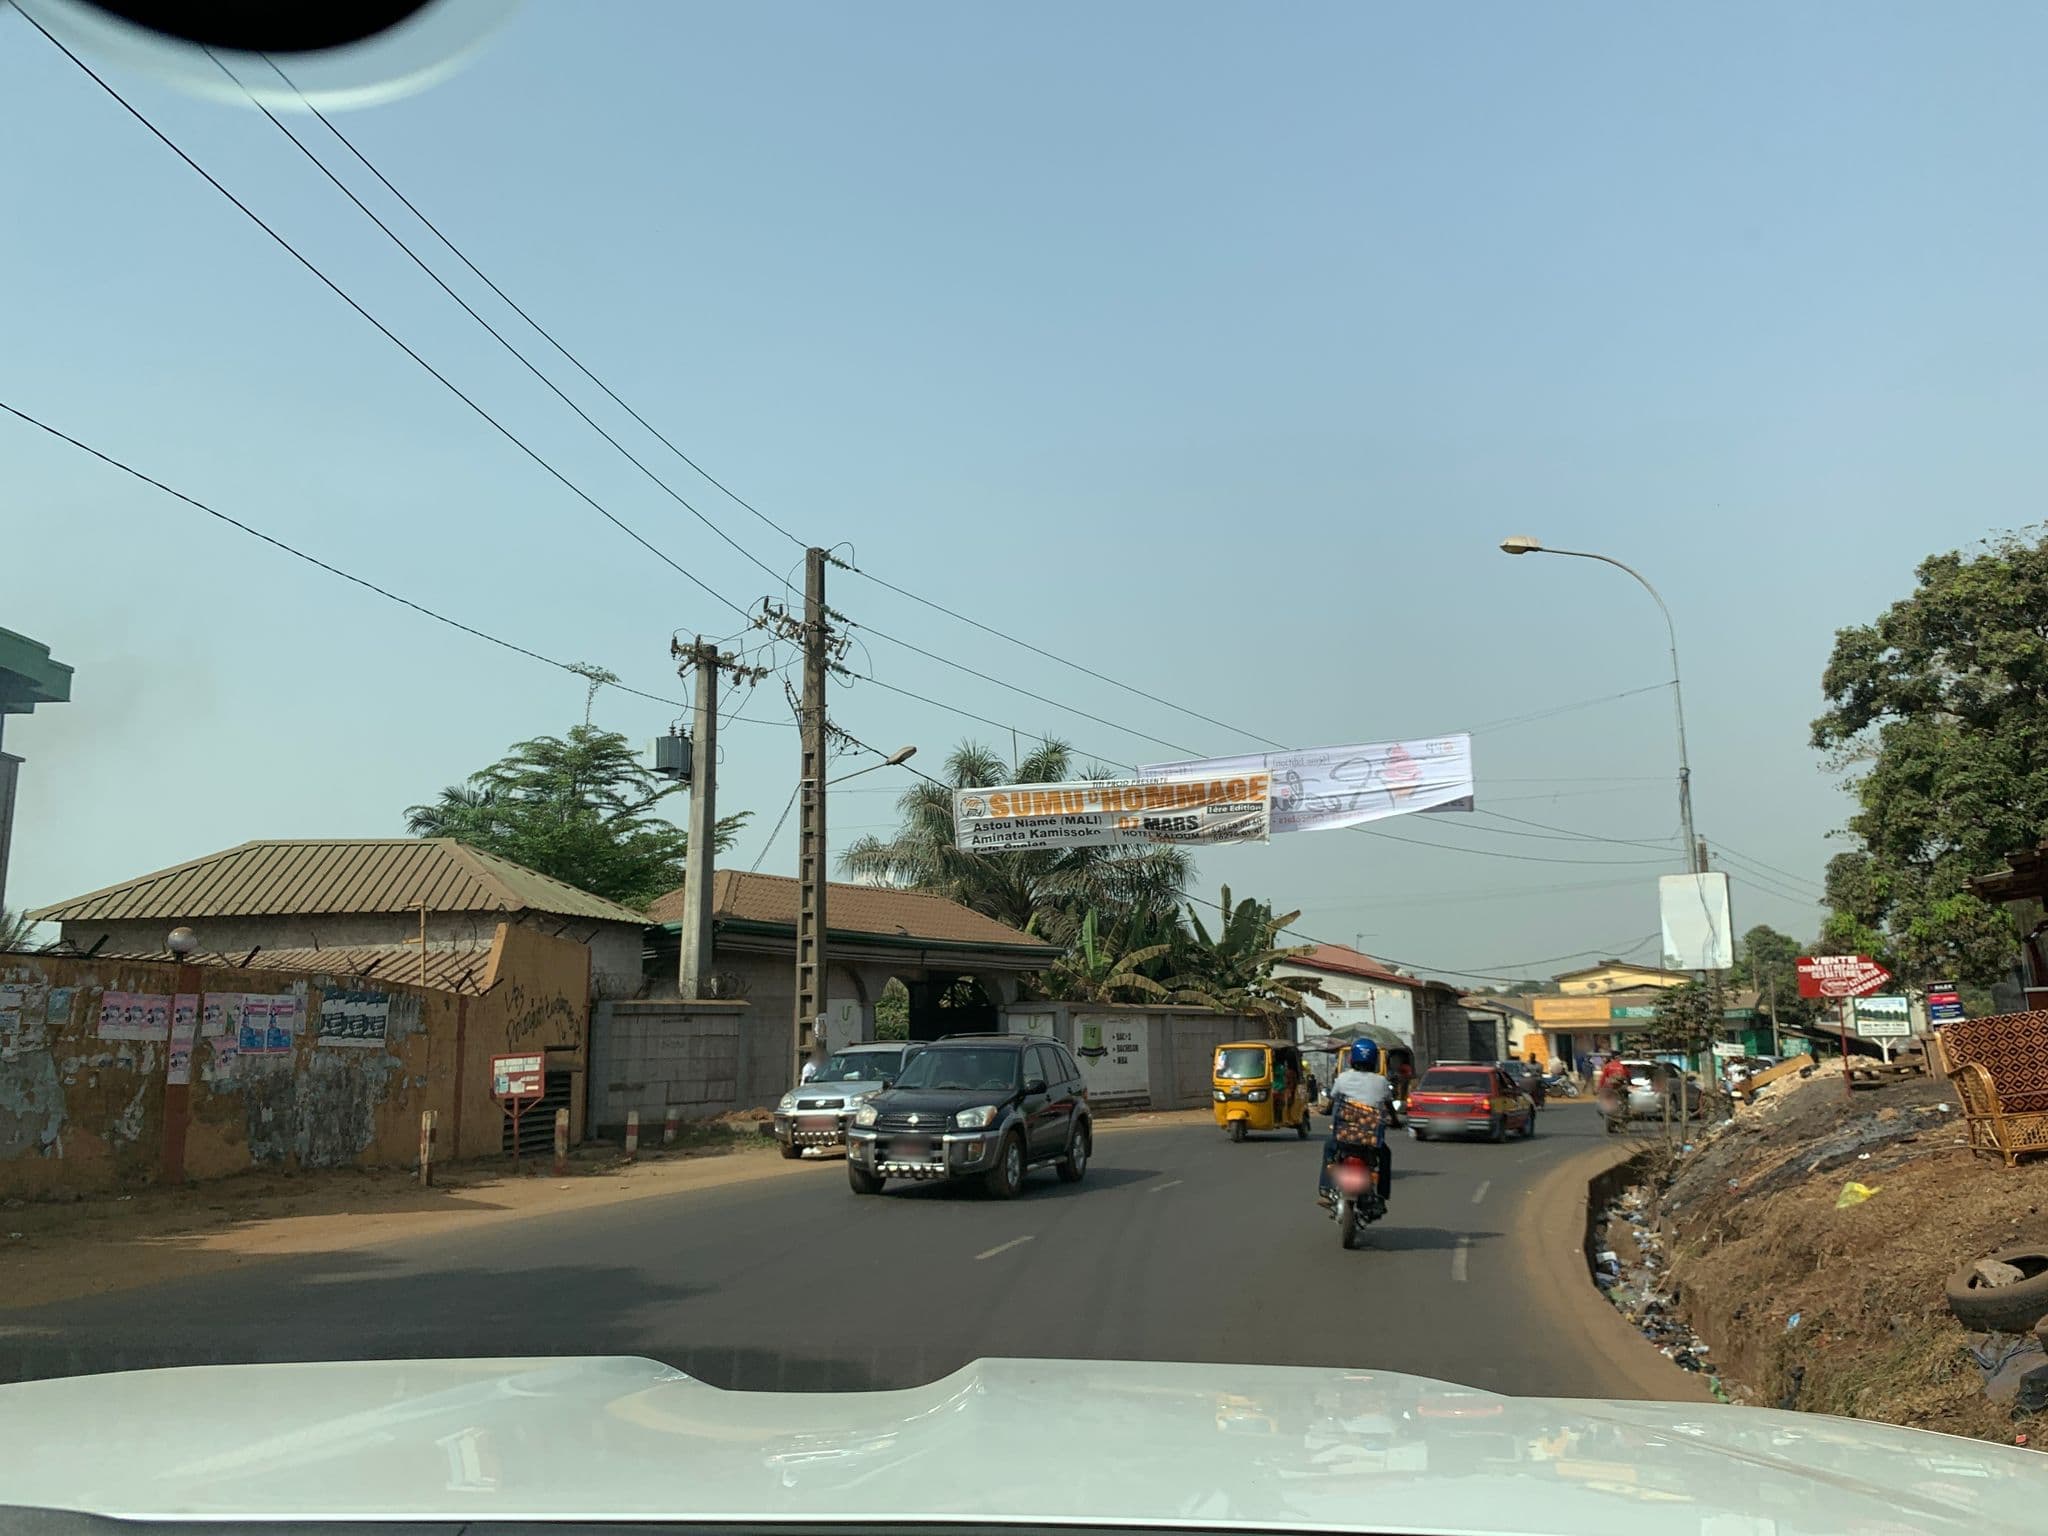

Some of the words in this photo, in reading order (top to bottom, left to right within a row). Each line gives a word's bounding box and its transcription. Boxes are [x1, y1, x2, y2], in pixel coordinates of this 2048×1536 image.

[988, 791, 1085, 819] SUMU
[973, 820, 1011, 833] Astou
[1015, 816, 1057, 828] Niamé
[1061, 815, 1102, 826] (MALI)
[1143, 815, 1199, 831] MARS
[971, 831, 1026, 845] Aminata
[1030, 828, 1102, 839] Kamissoko
[1122, 830, 1151, 838] HOTEL
[1155, 832, 1200, 841] KALOUM
[1811, 956, 1858, 965] VENTE
